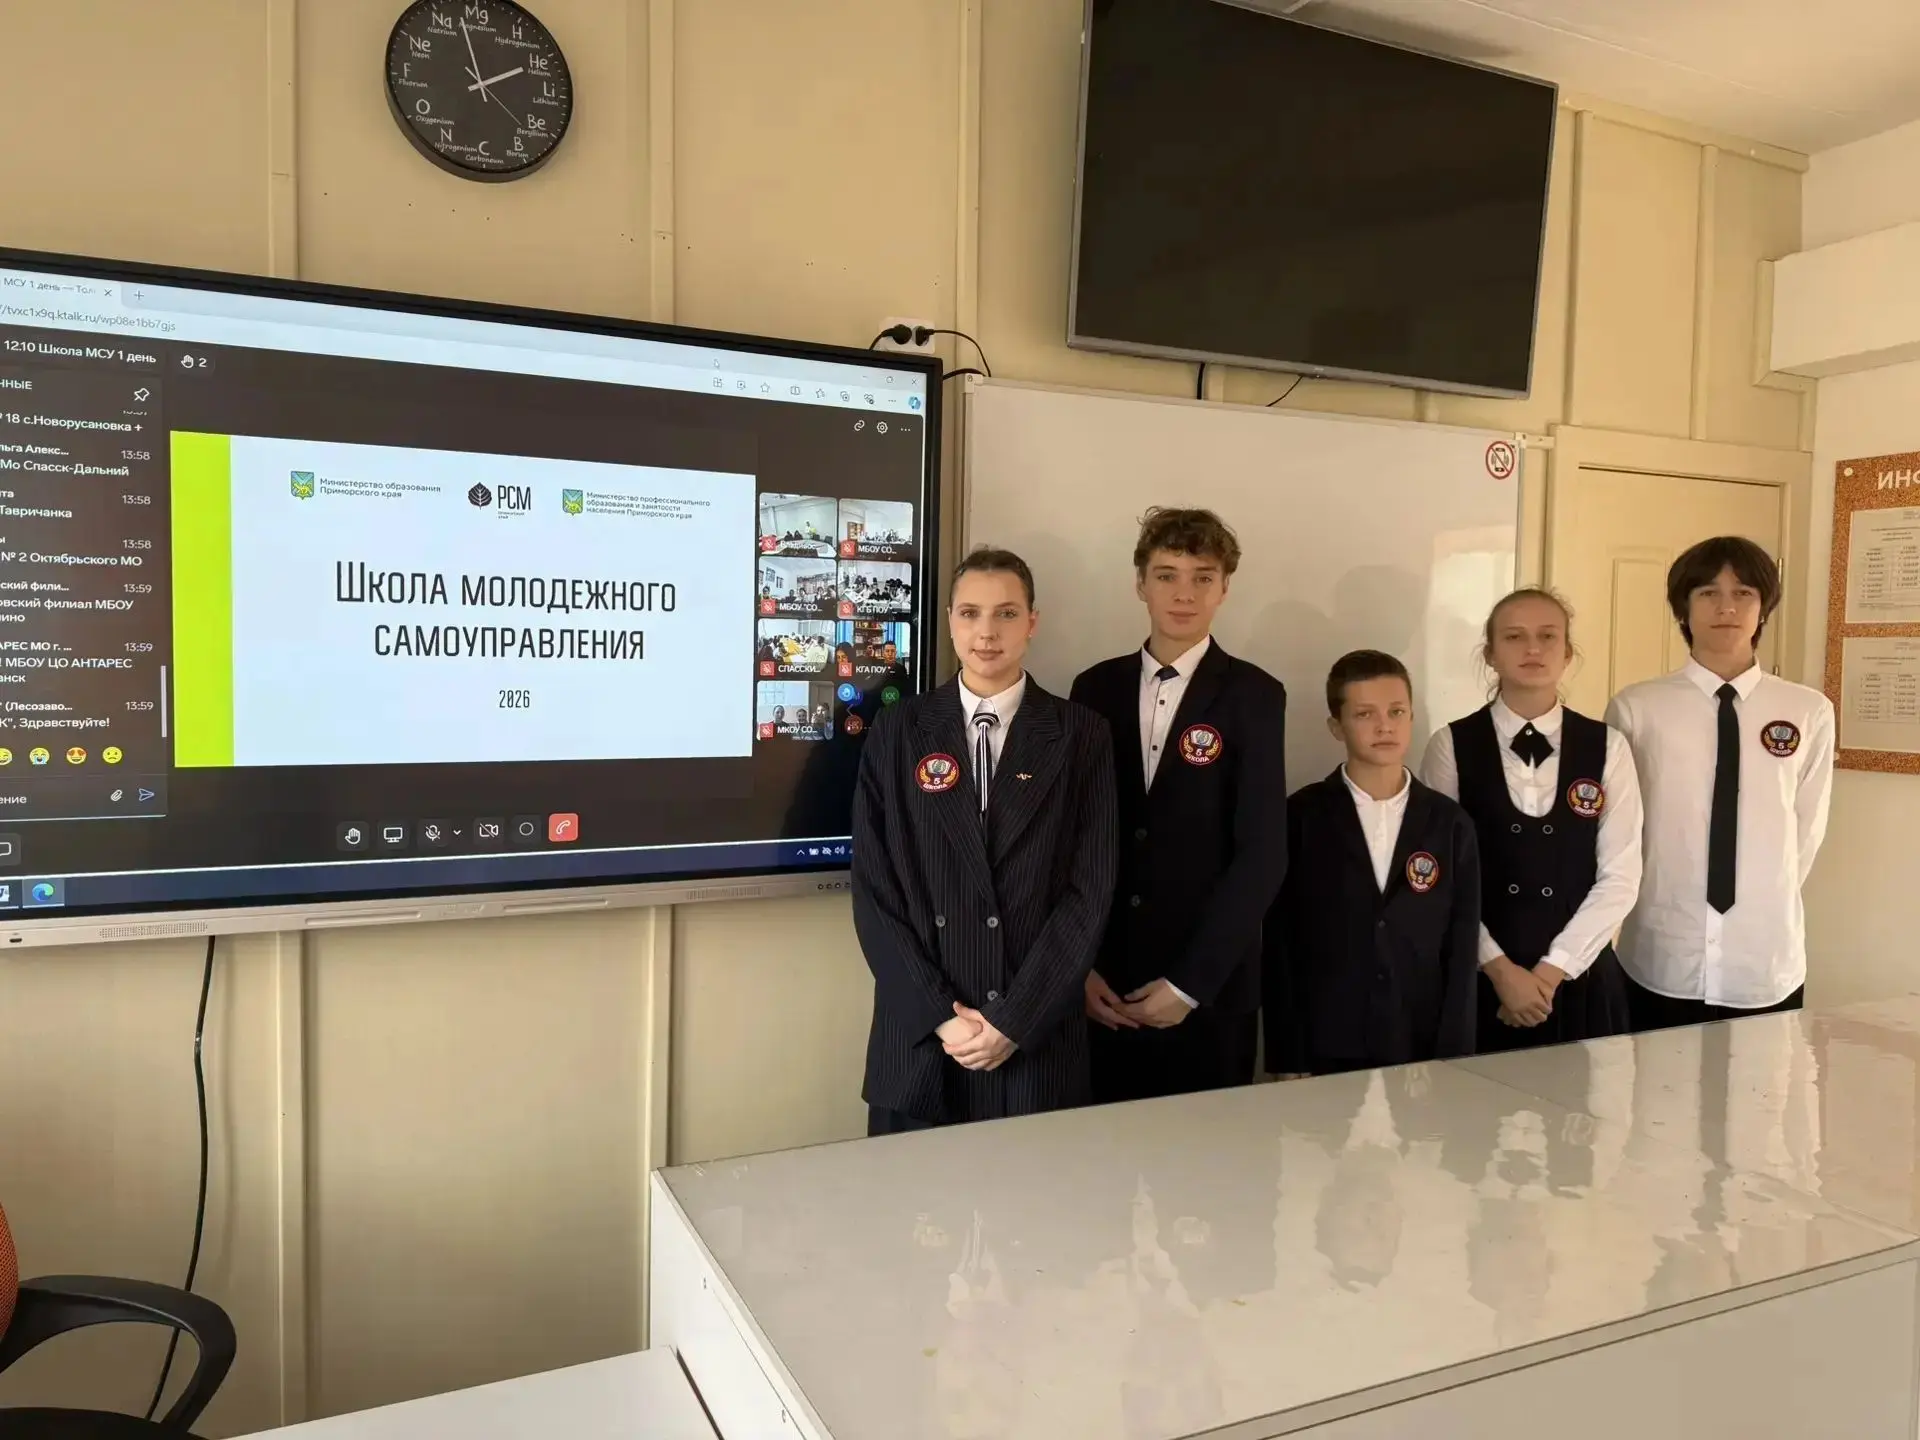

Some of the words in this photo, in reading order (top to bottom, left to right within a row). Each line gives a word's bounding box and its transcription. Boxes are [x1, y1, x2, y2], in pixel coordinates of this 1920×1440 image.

[432, 12, 452, 29] Na
[465, 5, 489, 24] Mg
[427, 26, 457, 36] Natrium
[512, 25, 522, 40] H
[409, 35, 431, 52] Ne
[529, 53, 548, 70] He
[403, 62, 411, 78] F
[543, 81, 556, 97] Li
[416, 98, 430, 115] O
[527, 114, 546, 130] Be
[440, 128, 452, 142] N
[478, 141, 490, 155] C
[513, 136, 523, 152] B
[4, 277, 26, 287] МСУ
[29, 280, 34, 288] 1
[37, 283, 60, 291] день
[38, 343, 83, 357] Школа
[85, 347, 115, 360] МСУ
[118, 351, 124, 360] 1
[126, 353, 157, 364] день
[198, 358, 208, 368] 2
[5, 413, 20, 424] 18
[23, 415, 132, 432] с.Новорусановка
[121, 450, 151, 461] 13:58
[0, 459, 21, 470] Мо
[23, 461, 130, 477] Спасск-Дальний
[320, 478, 383, 489] Министерство
[385, 482, 441, 492] образования
[122, 494, 151, 505] 13:58
[320, 486, 380, 497] Приморского
[381, 491, 402, 499] края
[497, 485, 531, 510] РСМ
[0, 505, 73, 519] Тавричанка
[123, 539, 152, 549] 13:58
[1, 552, 16, 562] №
[18, 552, 28, 563] 2
[29, 552, 118, 566] Октябрьского
[120, 556, 143, 566] МО
[123, 584, 152, 594] 13:59
[43, 598, 93, 610] филиал
[95, 600, 134, 611] МБОУ
[30, 641, 51, 651] МО
[124, 642, 153, 652] 13:59
[5, 657, 45, 668] МБОУ
[48, 657, 69, 669] ЦО
[71, 658, 133, 669] АНТАРЕС
[125, 701, 154, 711] 13:59
[499, 690, 531, 708] 2026
[19, 717, 110, 730] Здравствуйте!
